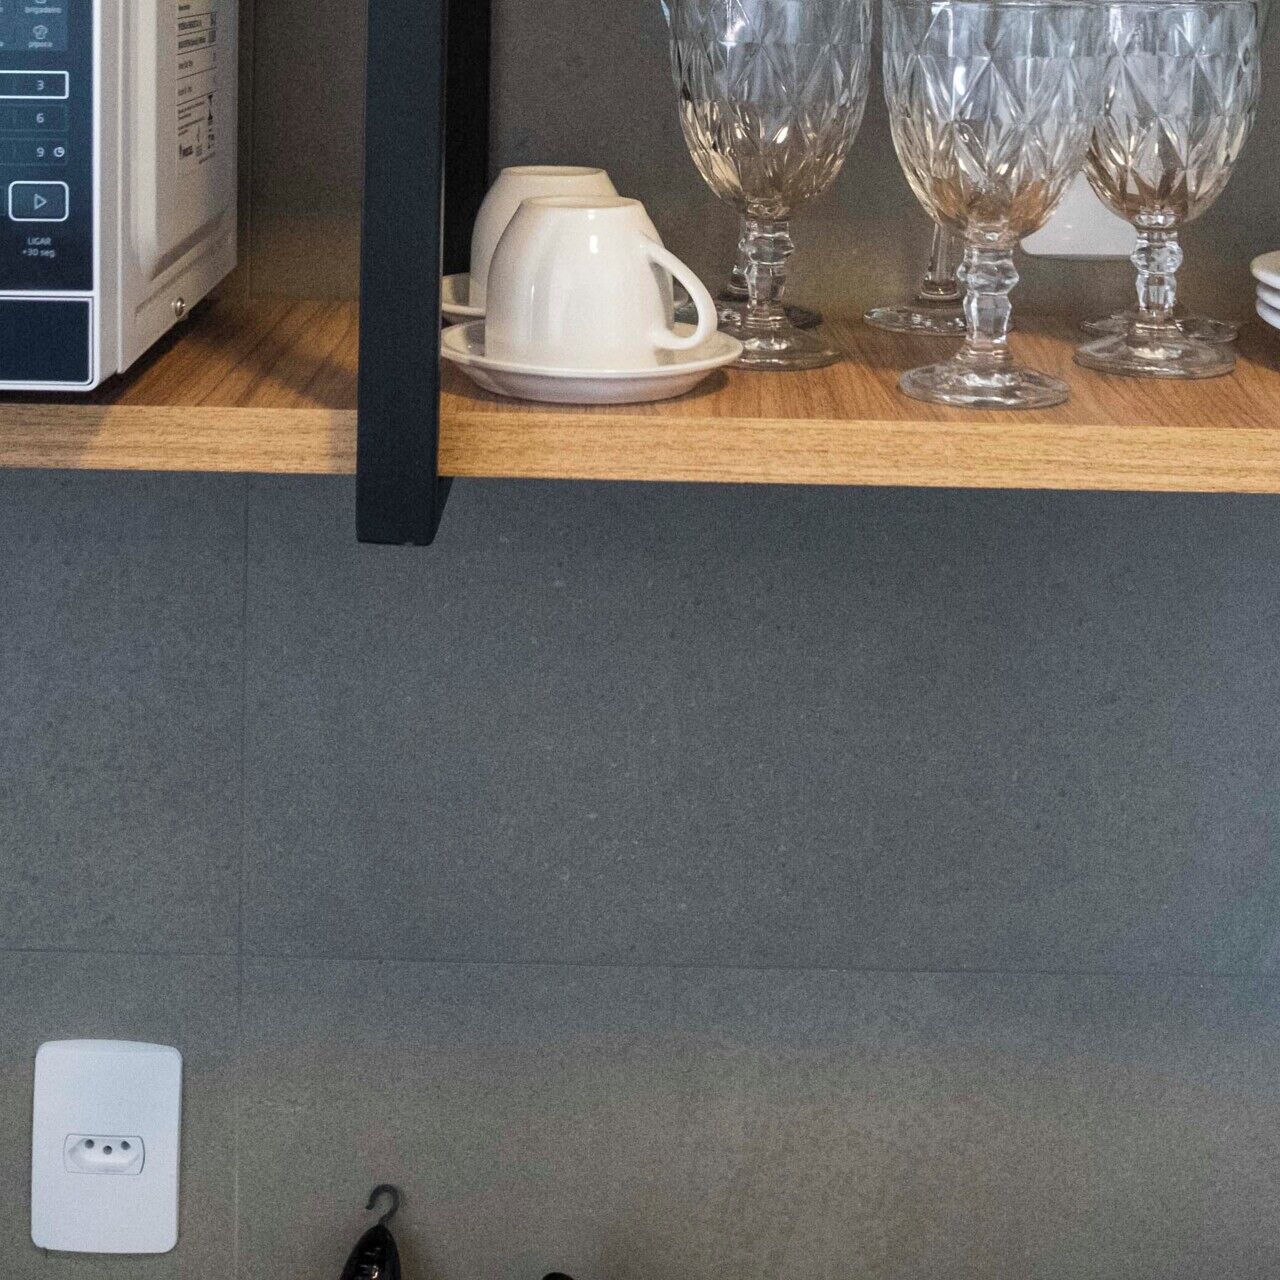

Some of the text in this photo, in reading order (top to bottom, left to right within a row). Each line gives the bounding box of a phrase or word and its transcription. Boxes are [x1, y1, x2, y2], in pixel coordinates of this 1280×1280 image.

[36, 80, 44, 91] 3
[35, 113, 44, 124] 6
[35, 147, 44, 157] 9
[27, 237, 51, 246] LIGAR
